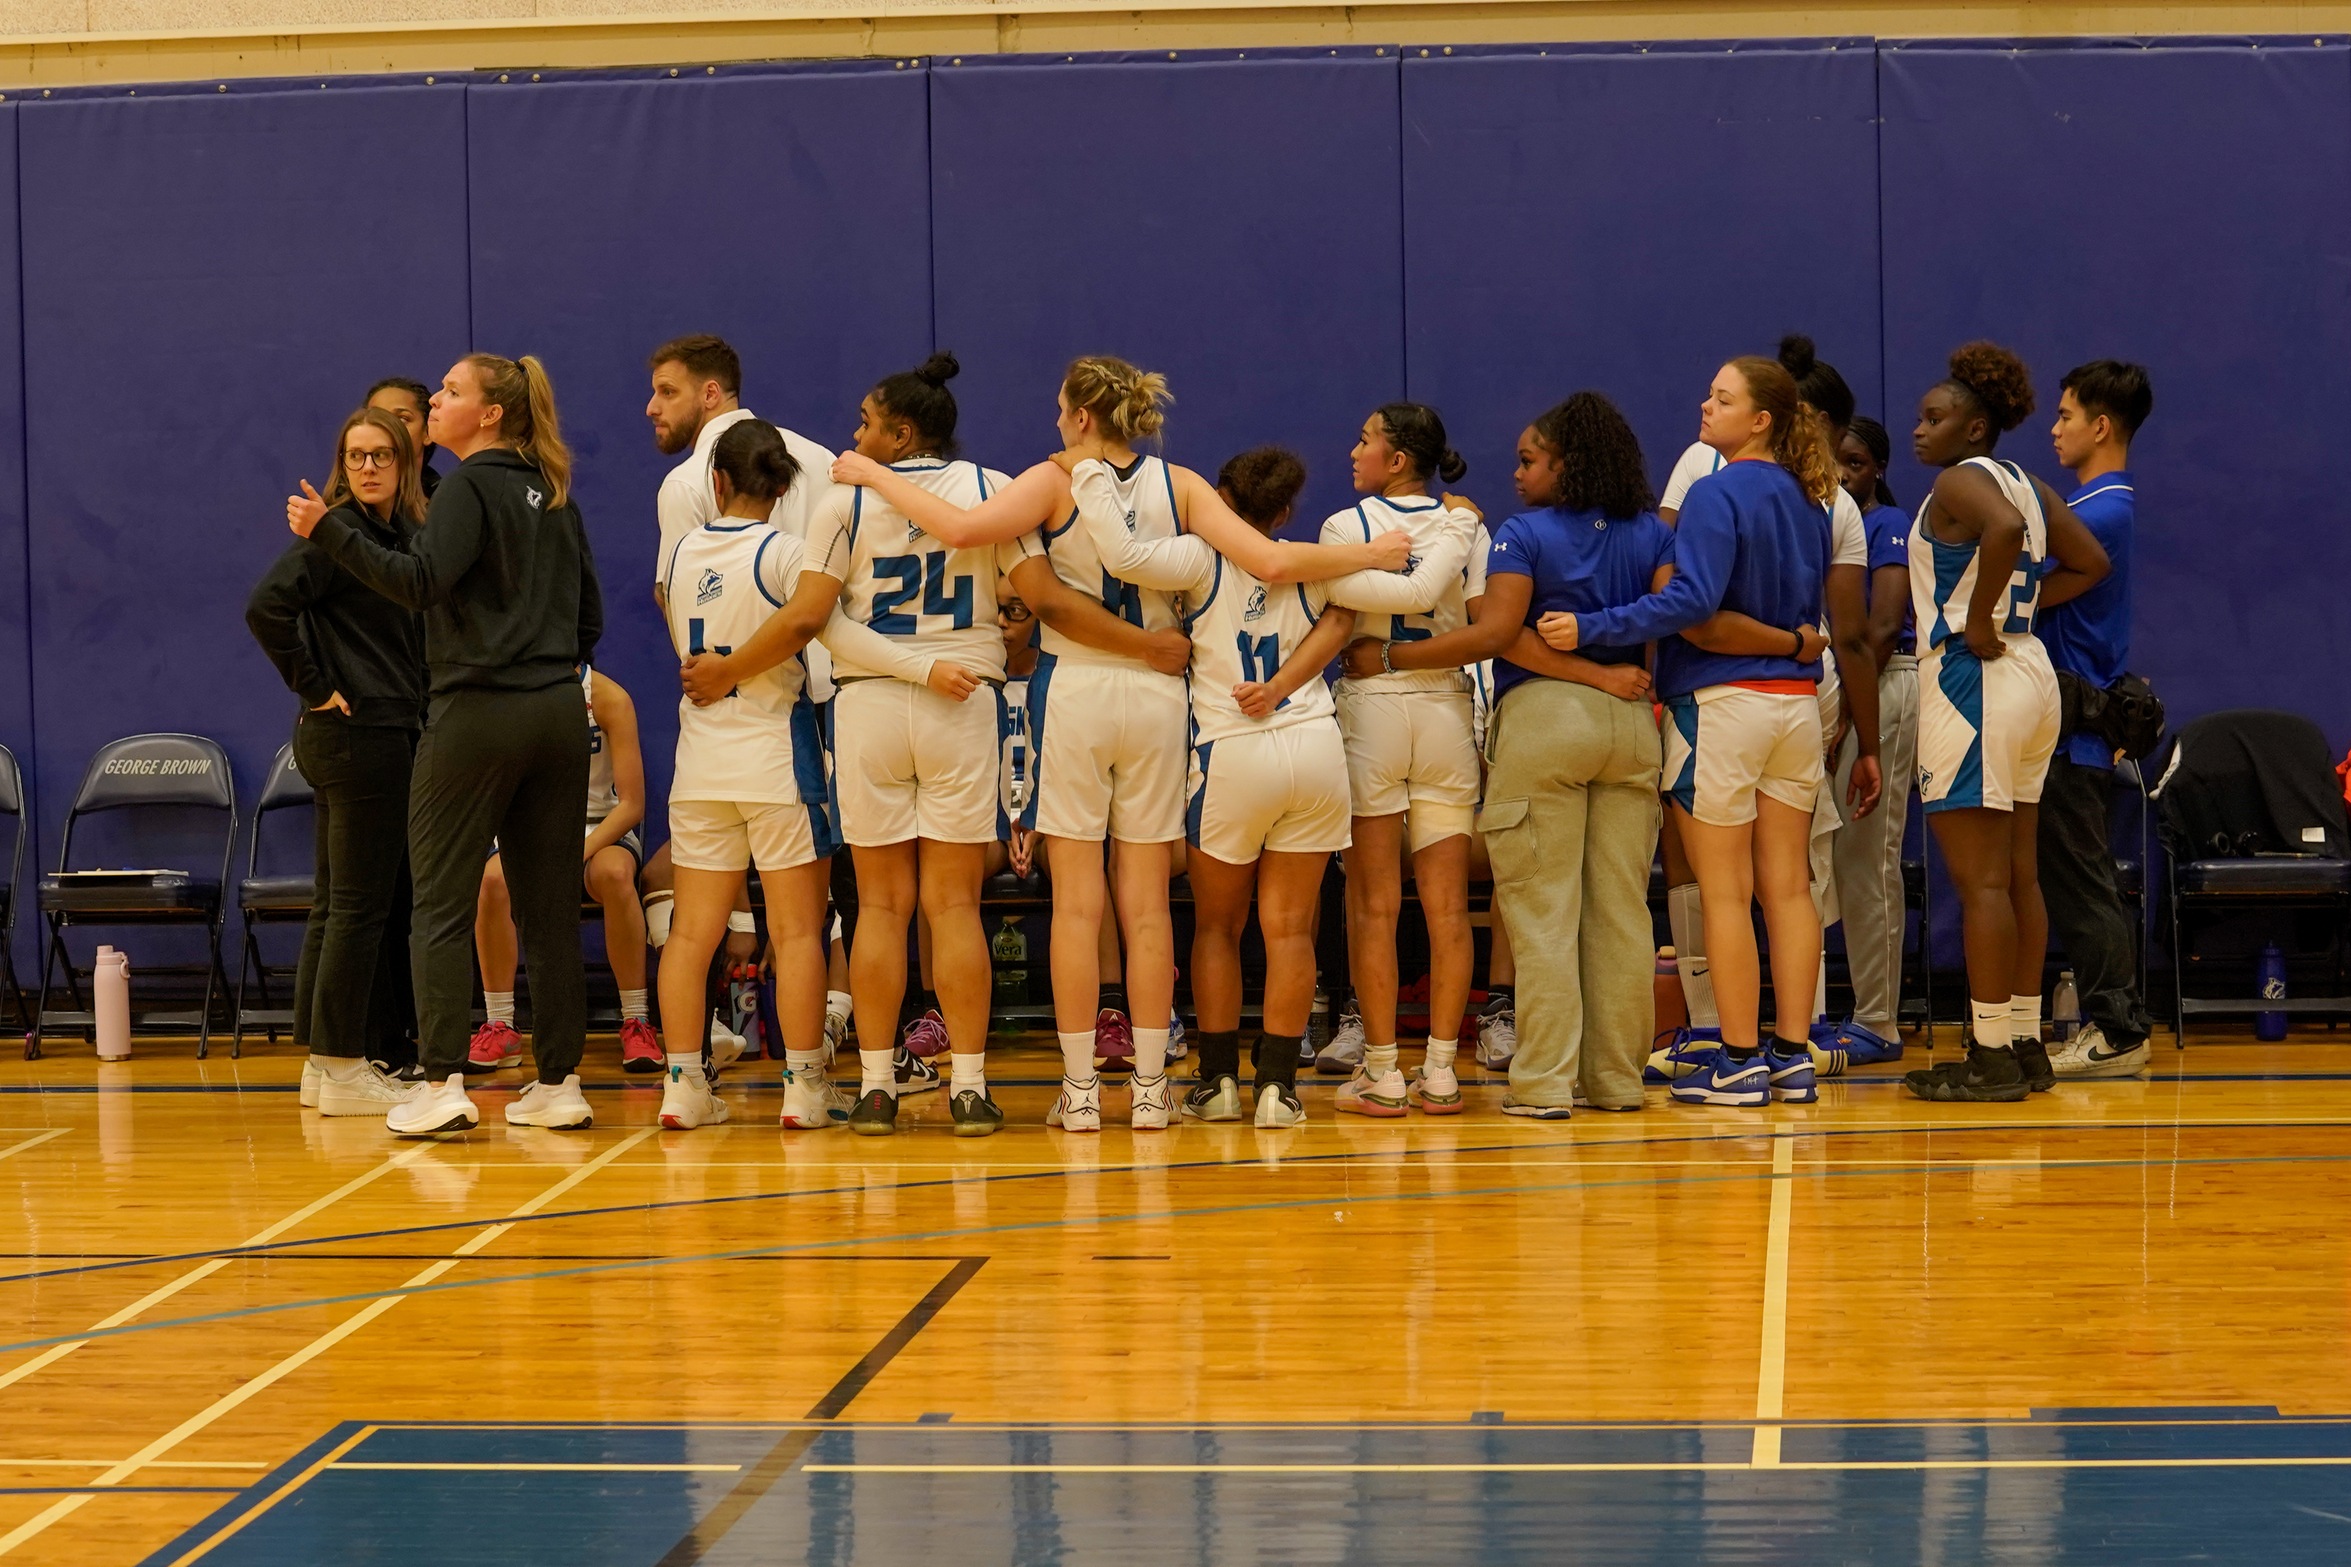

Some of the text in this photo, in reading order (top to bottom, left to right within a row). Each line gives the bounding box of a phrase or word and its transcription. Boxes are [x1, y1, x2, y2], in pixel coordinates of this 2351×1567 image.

[867, 550, 973, 635] 24
[105, 759, 212, 775] GEORGE BROWN
[994, 943, 1022, 957] Vera
